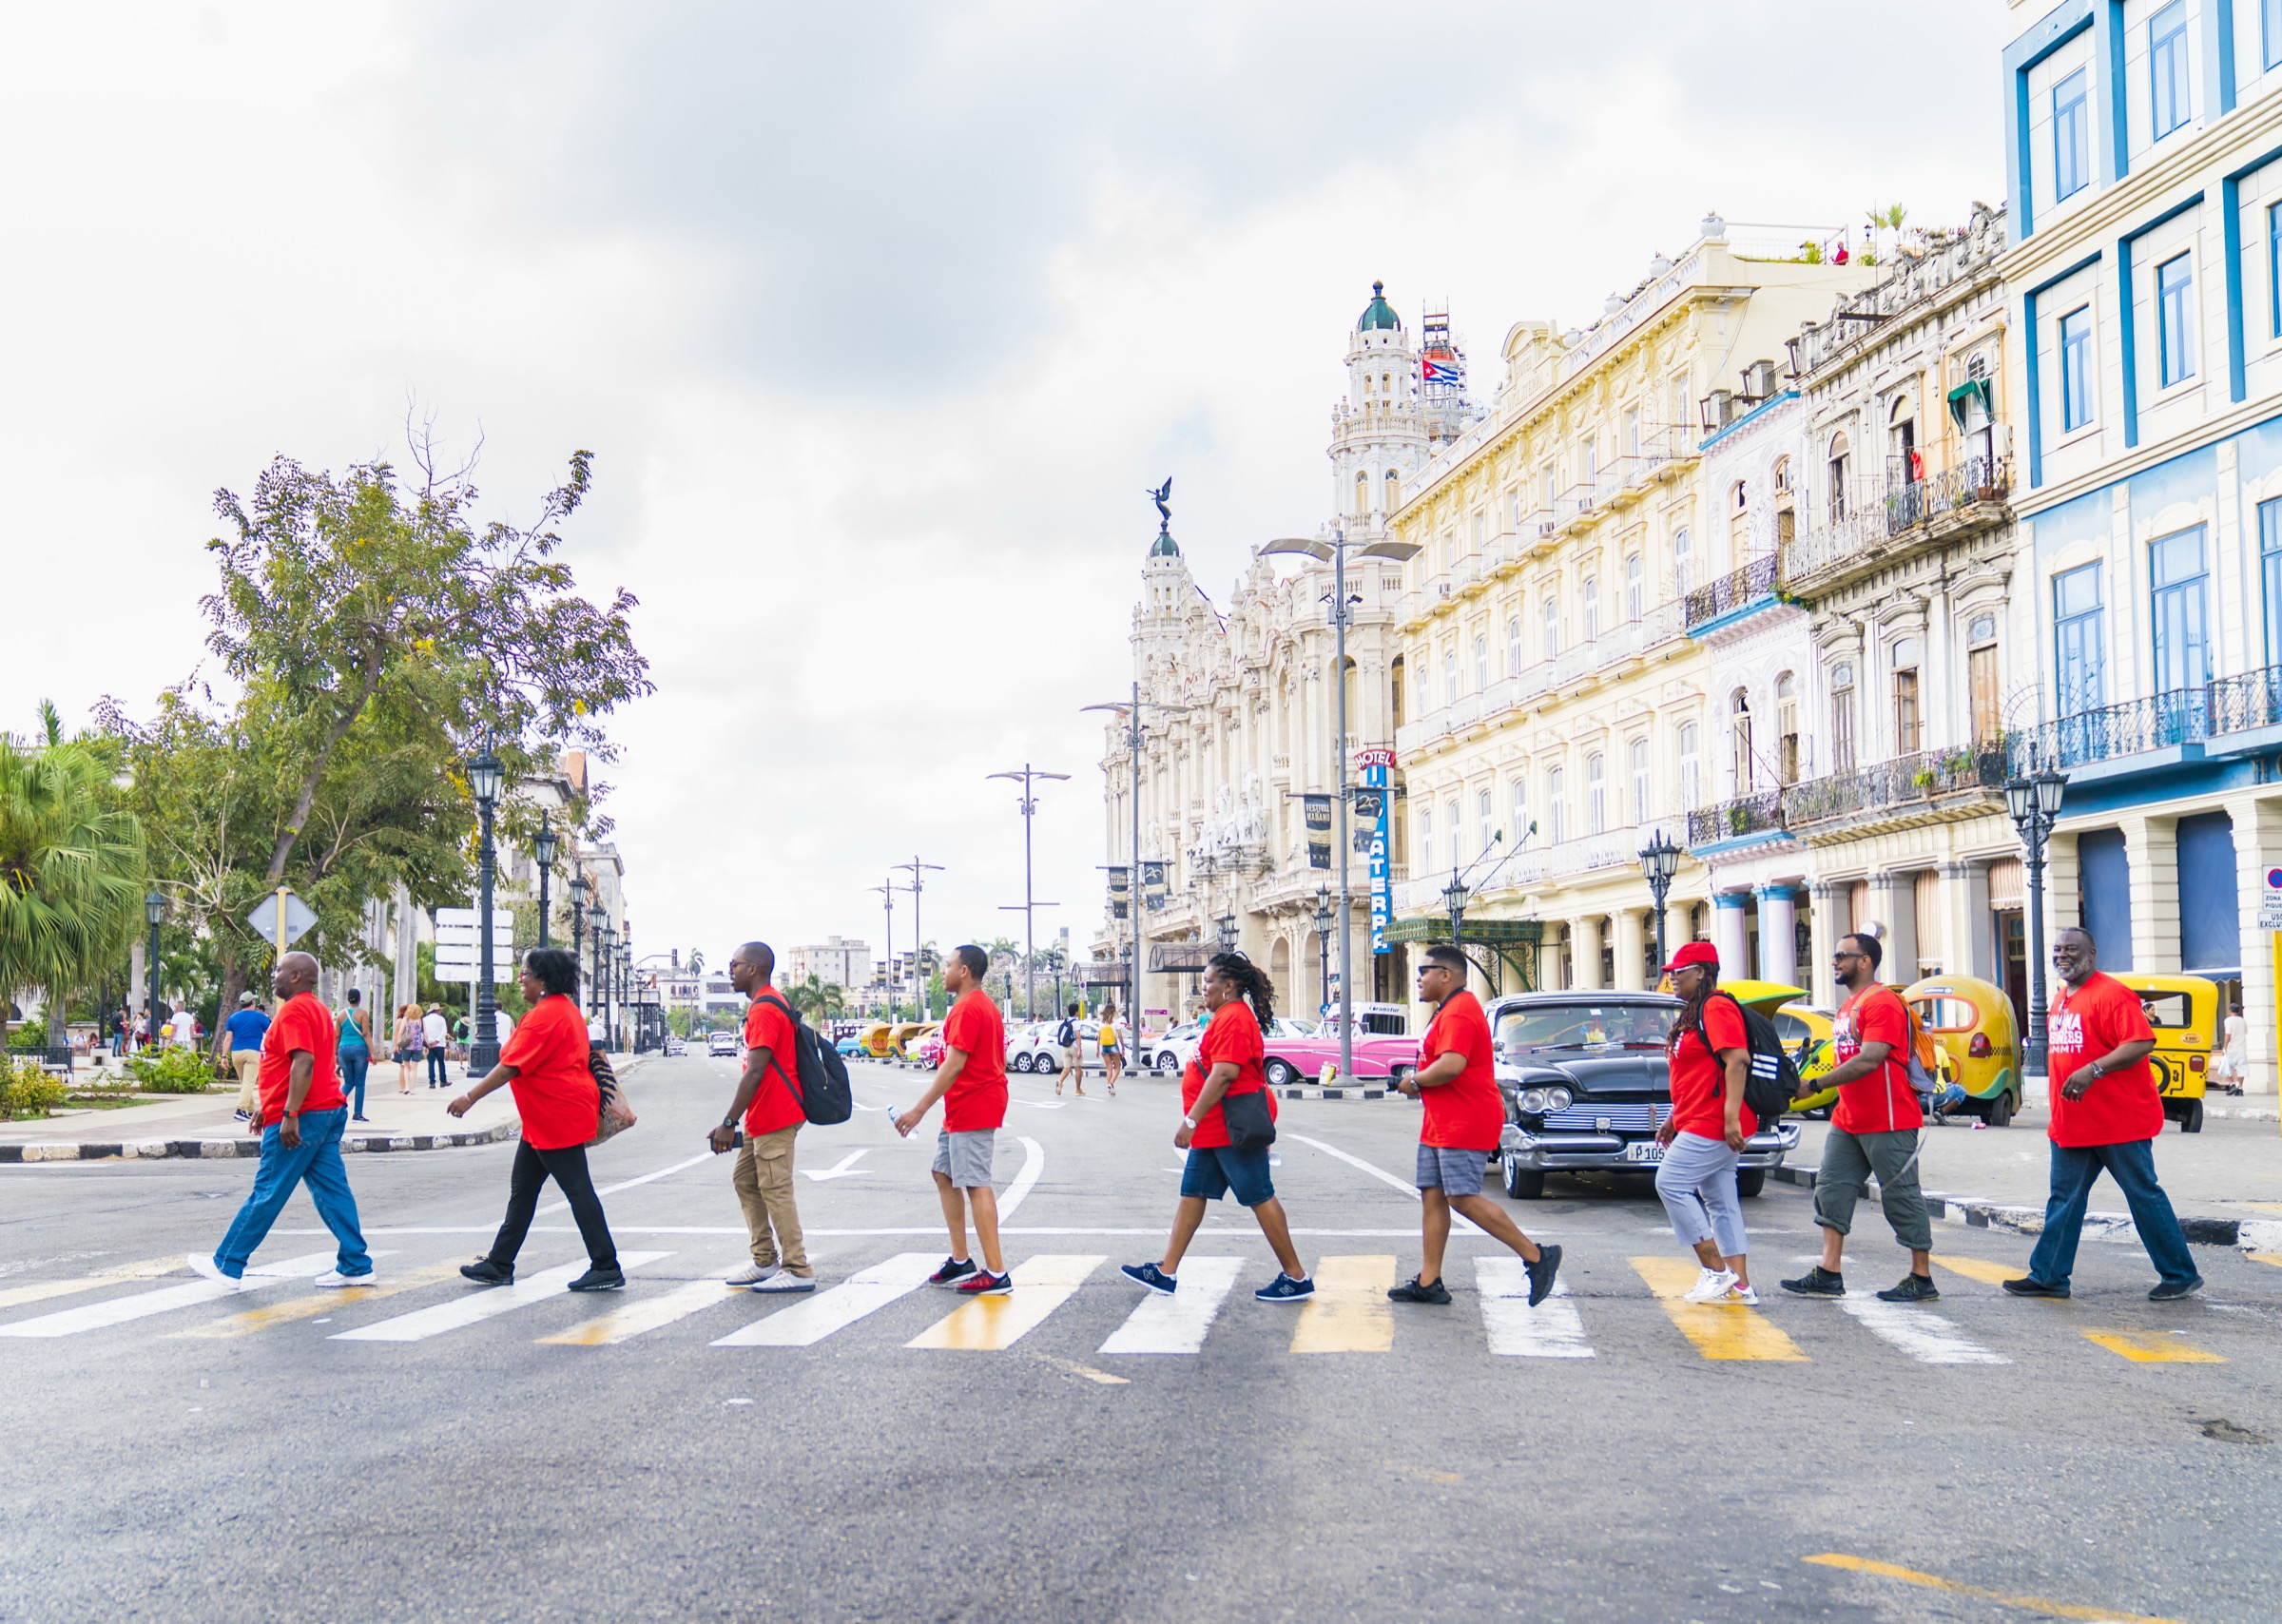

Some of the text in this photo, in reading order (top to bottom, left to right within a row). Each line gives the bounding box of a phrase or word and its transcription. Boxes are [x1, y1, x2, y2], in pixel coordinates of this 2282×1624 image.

[1355, 751, 1391, 768] HOTEL
[1306, 803, 1330, 813] FESTIVAL
[1635, 1148, 1643, 1160] P
